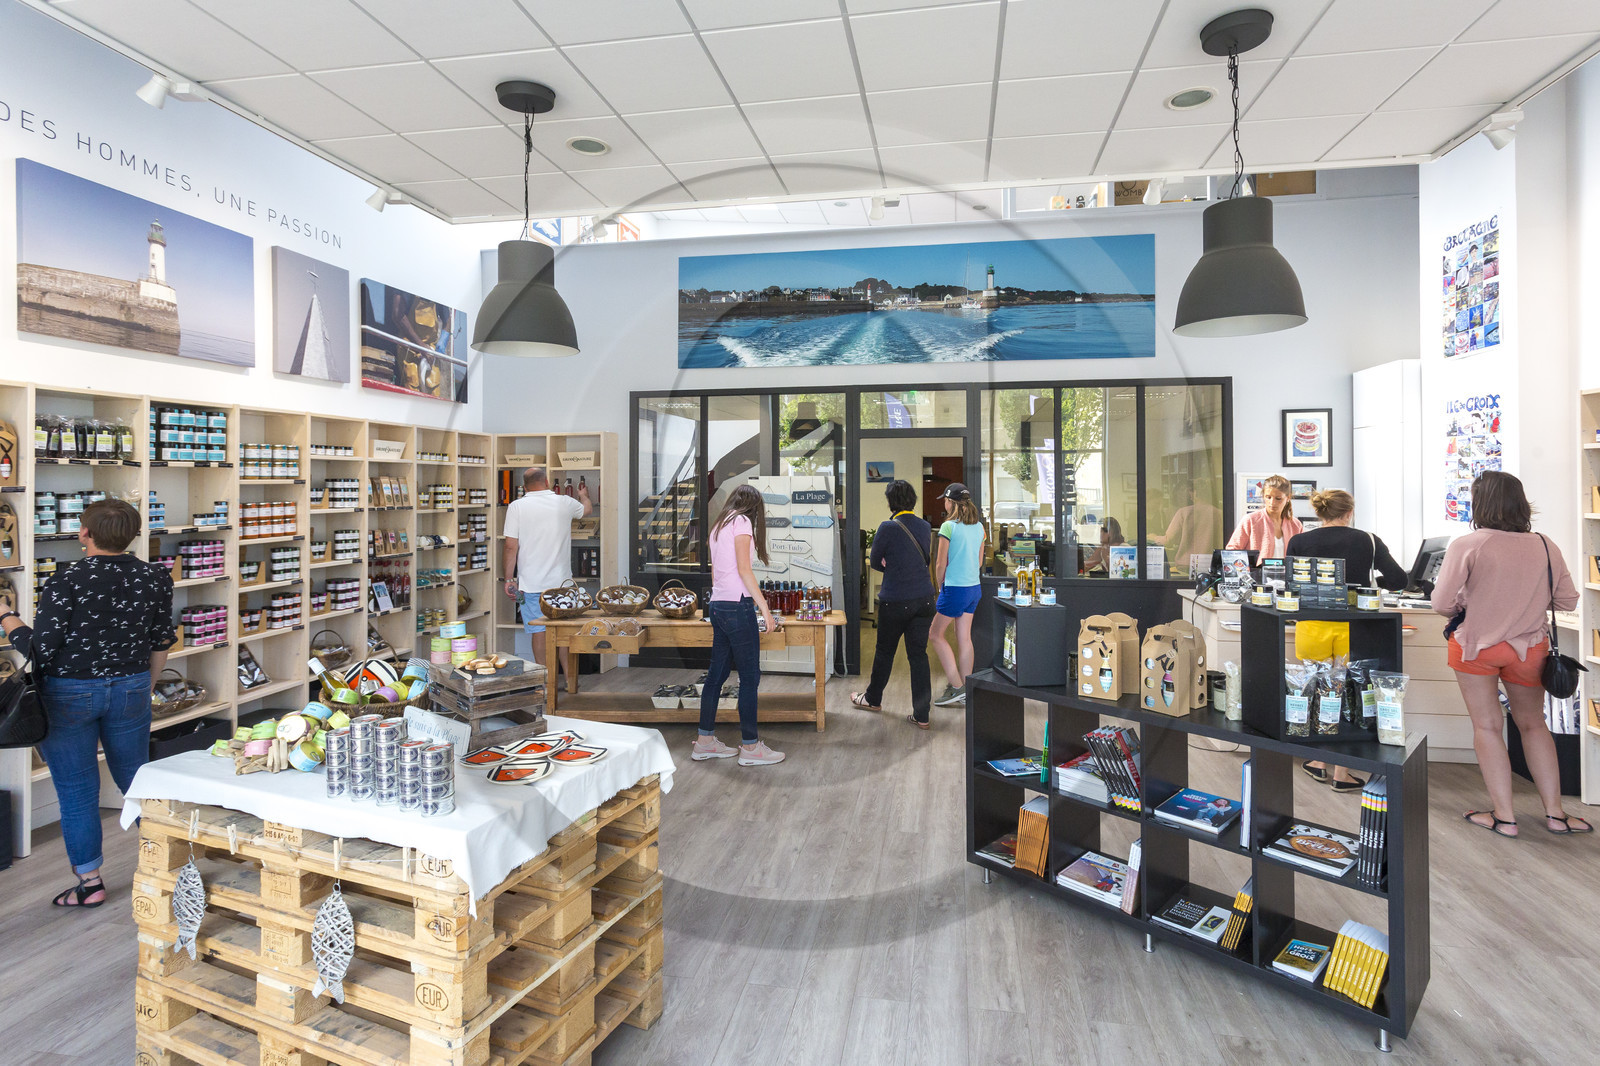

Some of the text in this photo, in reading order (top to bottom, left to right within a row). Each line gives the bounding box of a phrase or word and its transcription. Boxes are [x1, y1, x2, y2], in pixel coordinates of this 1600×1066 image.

[77, 132, 200, 197] HOMMES,
[214, 187, 257, 217] UNE
[268, 208, 342, 249] PASSION
[806, 492, 826, 501] Plage
[812, 518, 828, 526] Port
[427, 856, 447, 875] EUR
[135, 900, 154, 916] EPAL
[422, 986, 443, 1009] EUR
